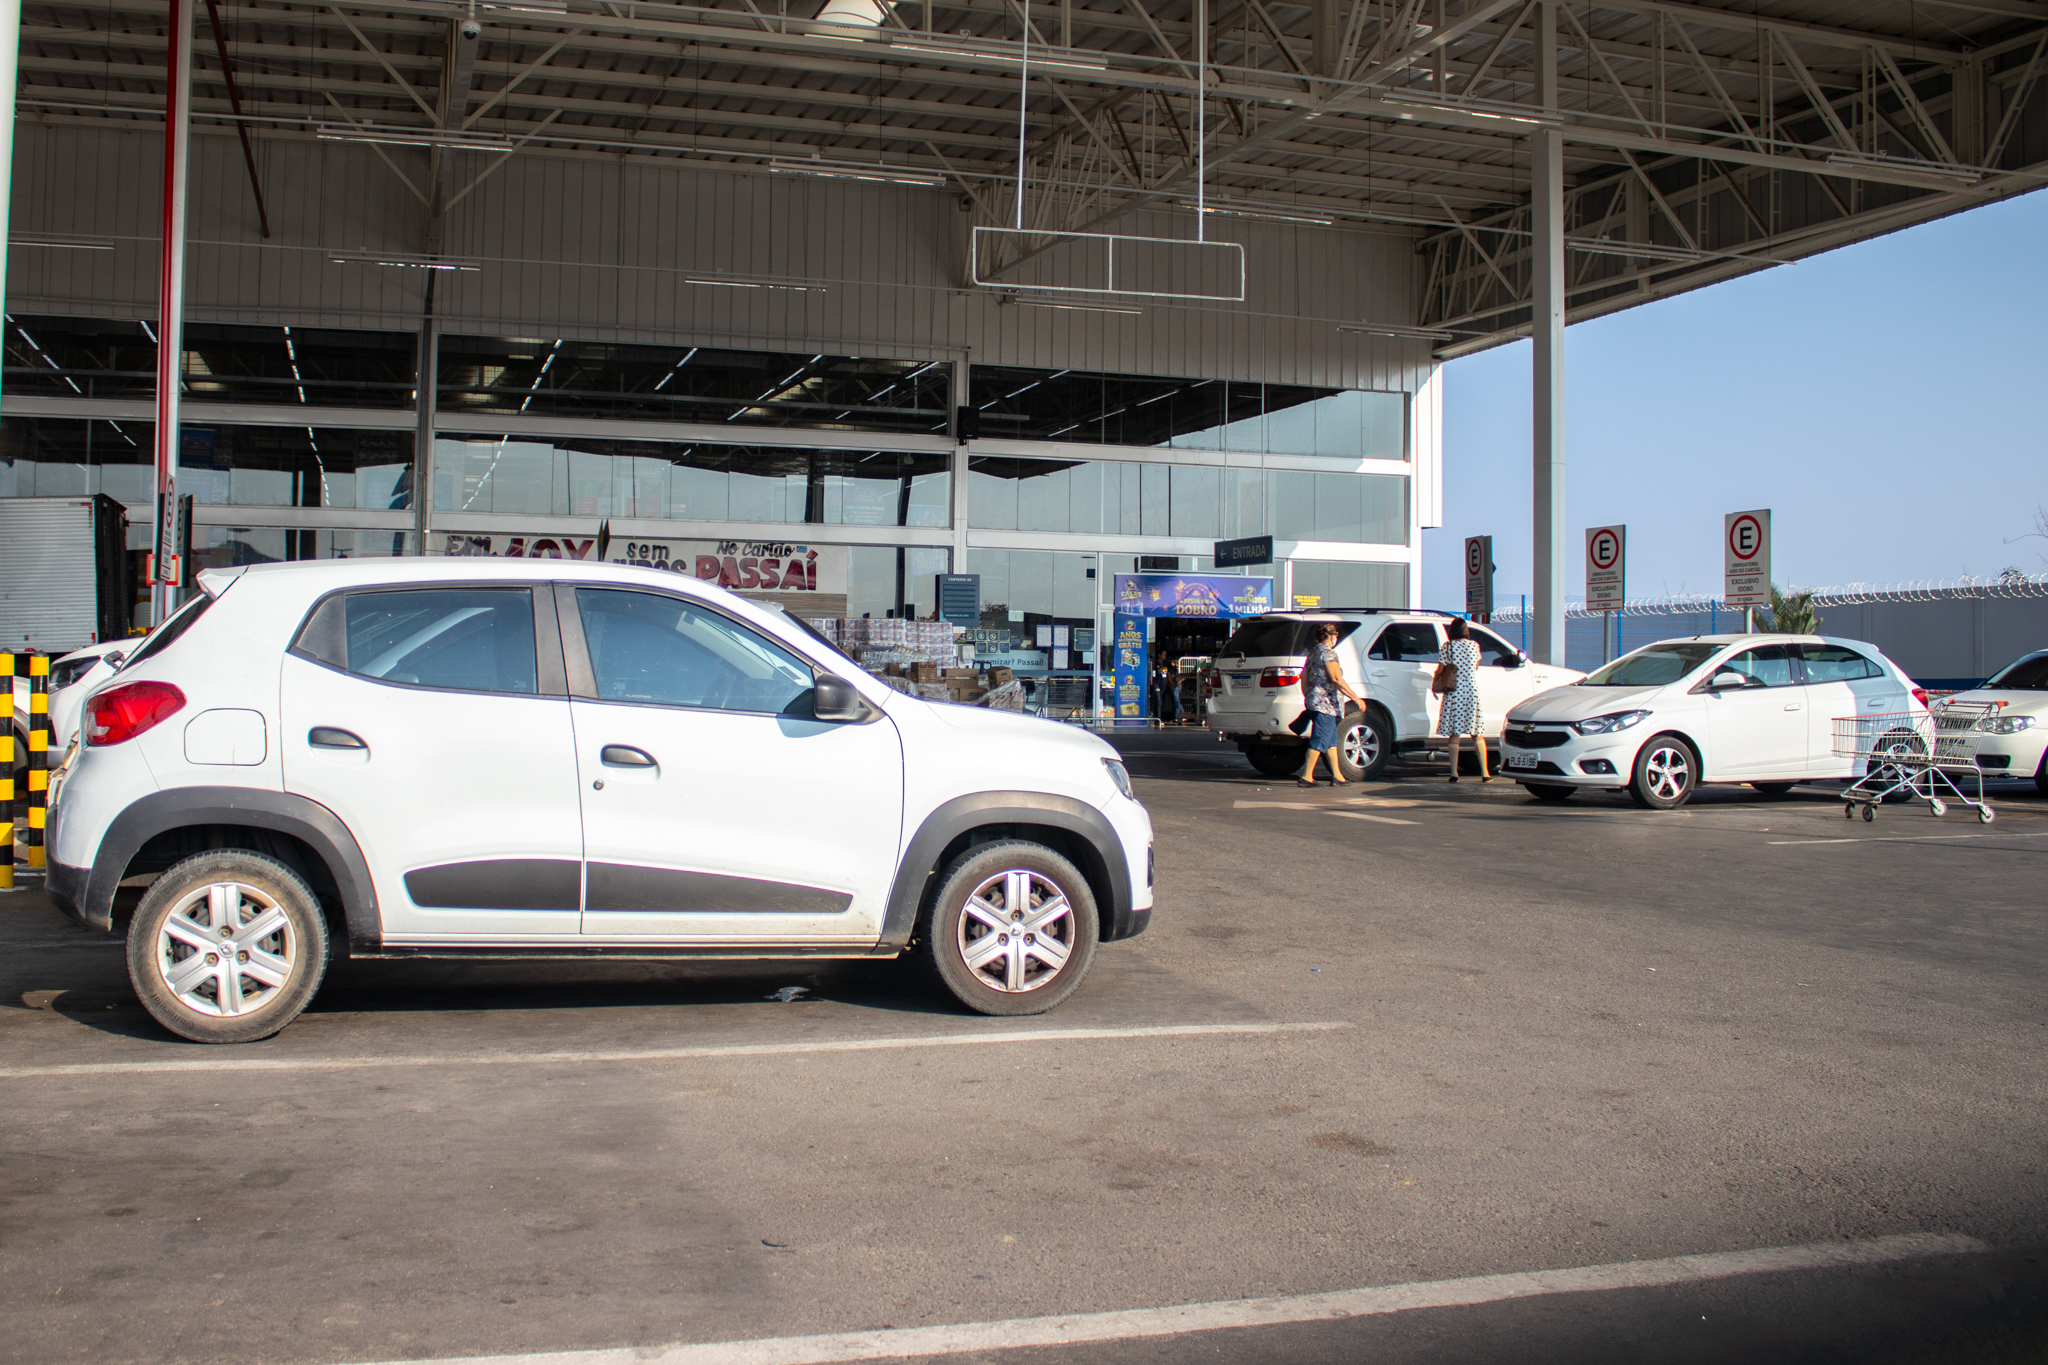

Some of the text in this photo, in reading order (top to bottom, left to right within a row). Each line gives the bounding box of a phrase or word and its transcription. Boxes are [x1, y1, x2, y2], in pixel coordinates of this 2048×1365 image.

[1740, 526, 1753, 550] E
[716, 541, 795, 558] No Cartão
[1232, 544, 1267, 560] ENTRADA
[1599, 539, 1610, 560] E
[1472, 548, 1478, 568] E
[695, 549, 818, 591] PASSAÍ
[1732, 577, 1759, 585] EXCLUSIVO
[1246, 587, 1254, 597] 2
[1233, 596, 1268, 604] PRÊMIOS
[1176, 604, 1217, 616] DOBRO
[1235, 604, 1271, 614] MILHÃO
[1127, 621, 1134, 630] 2
[1017, 658, 1044, 667] Passaí!
[1127, 676, 1133, 684] 2
